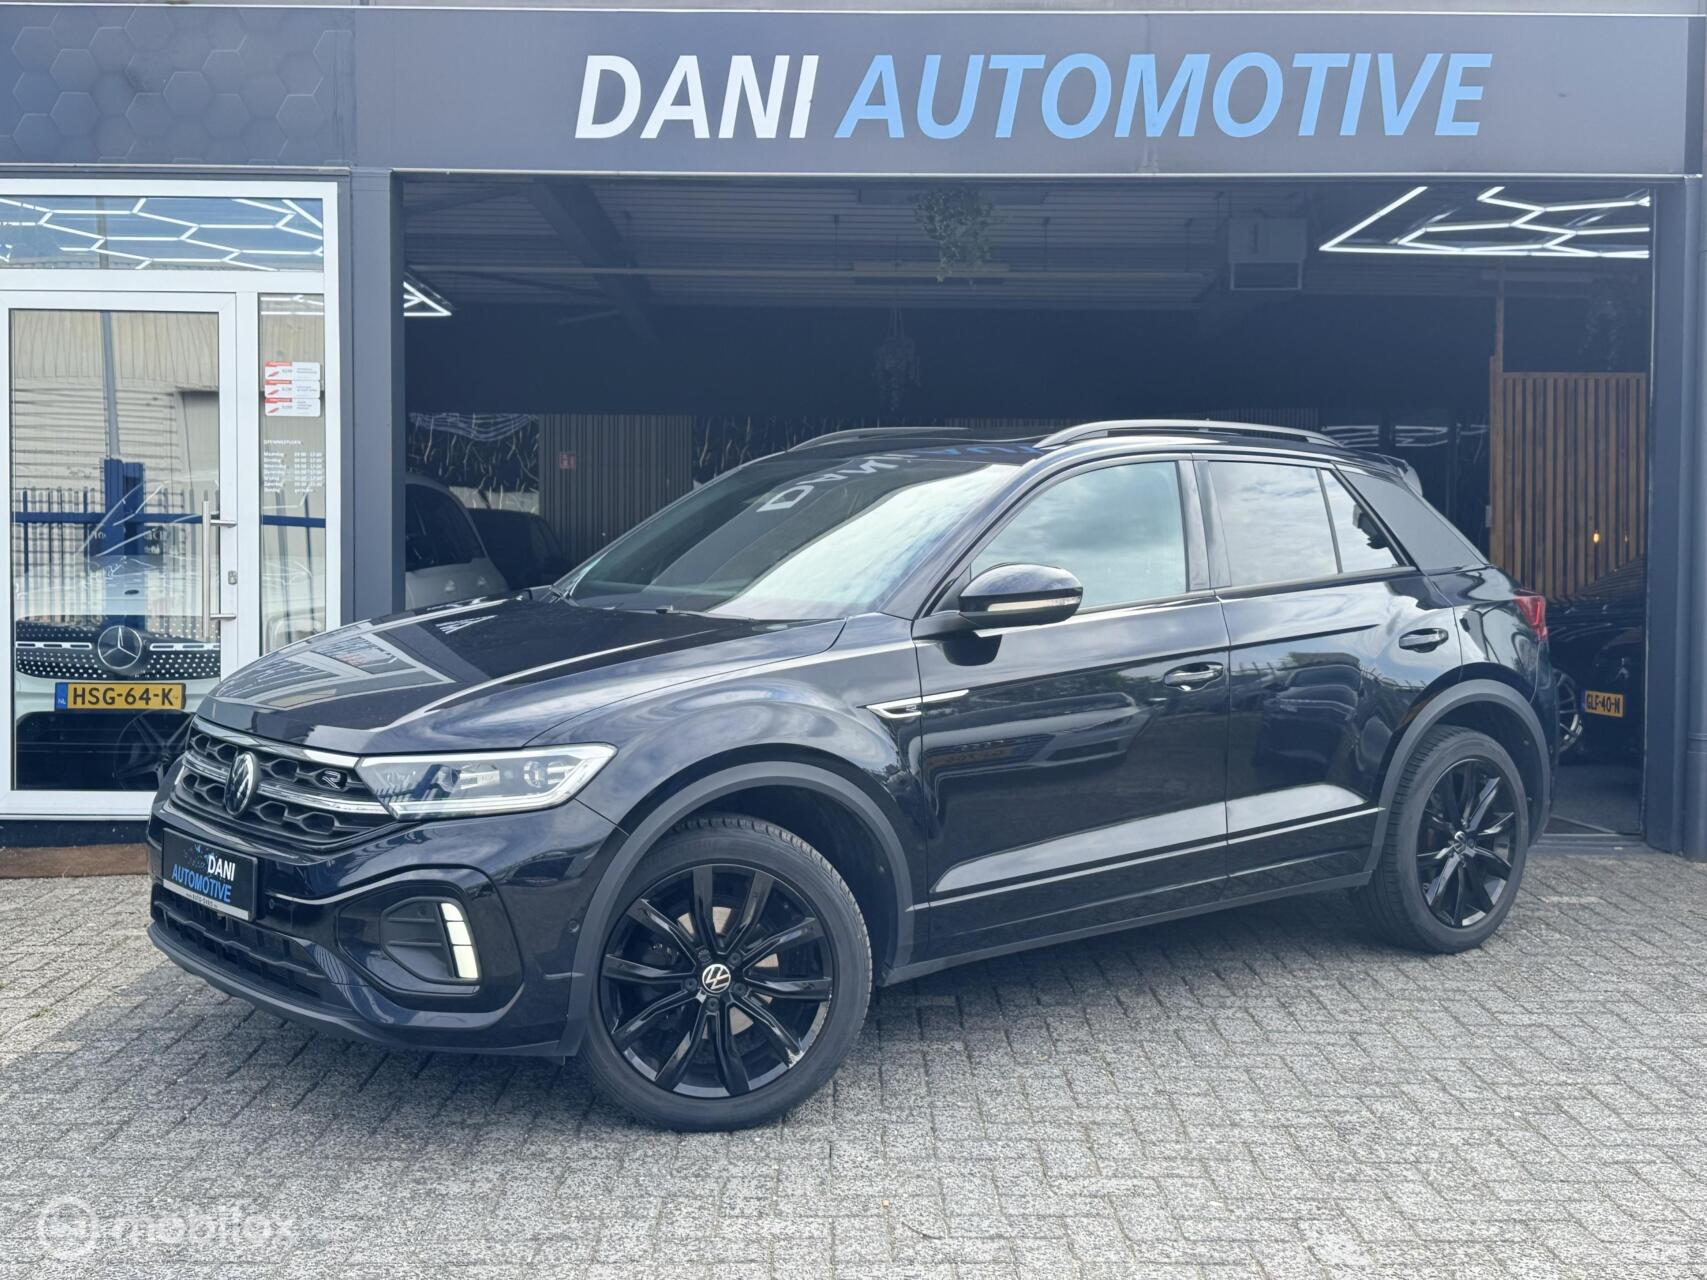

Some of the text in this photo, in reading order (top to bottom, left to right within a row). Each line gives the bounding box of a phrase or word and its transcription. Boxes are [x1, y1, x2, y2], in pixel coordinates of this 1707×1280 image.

[575, 51, 1492, 140] DANI AUTOMOTIVE
[72, 687, 173, 706] HSG-64-K
[171, 863, 232, 903] AUTOMOTIVE
[207, 854, 236, 881] DANI
